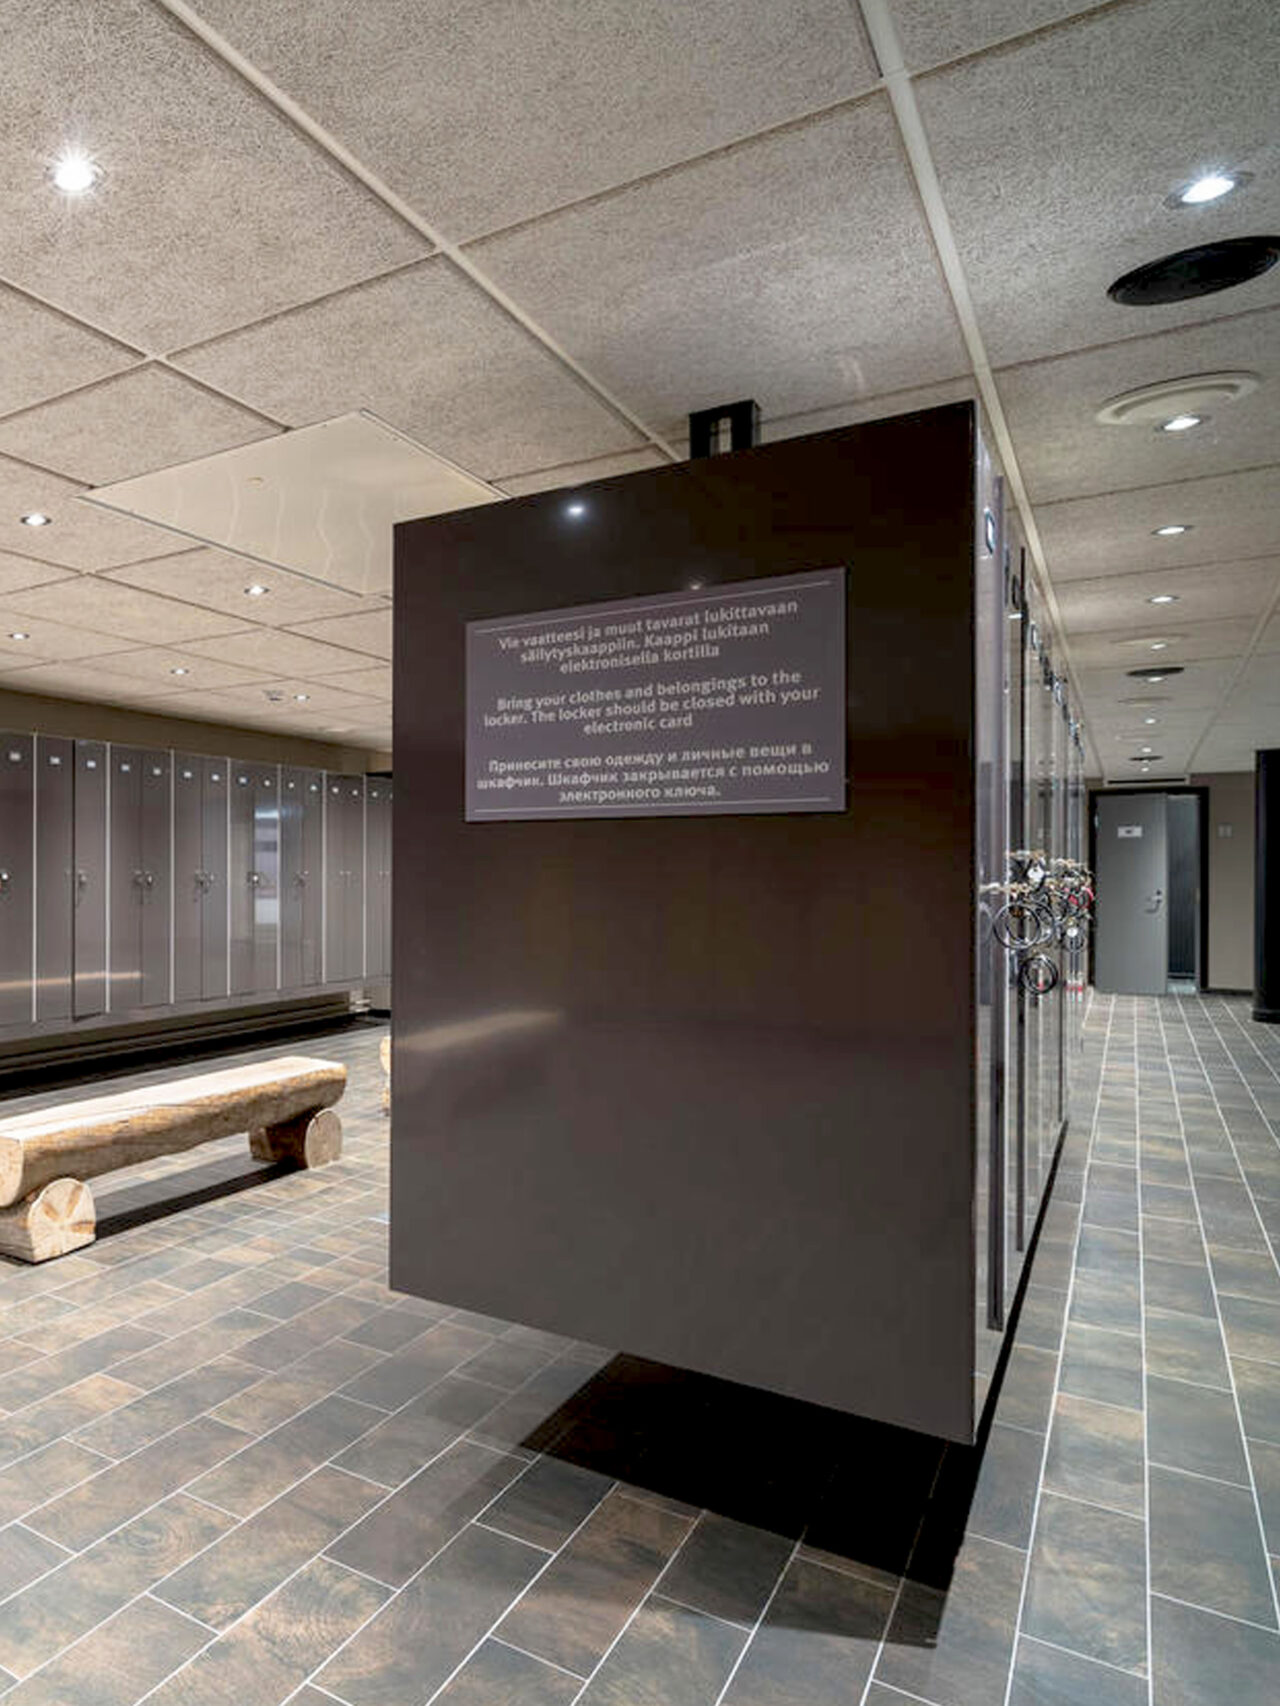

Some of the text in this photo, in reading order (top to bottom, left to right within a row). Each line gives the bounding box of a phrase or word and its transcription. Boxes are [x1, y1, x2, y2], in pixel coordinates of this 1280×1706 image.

[498, 601, 798, 650] Vie vaatteesi ja muut tavarat lukittavaan
[521, 622, 769, 663] säilytyskaappiin. Kaappi lukitaan
[560, 645, 720, 674] elektronisella kortilla
[497, 670, 801, 711] Bring your clothes and belongings to the
[484, 688, 821, 727] locker. The locker should be closed with your
[584, 714, 693, 735] electronic card
[488, 758, 561, 774] Принесите
[564, 756, 602, 768] свою
[605, 752, 663, 767] одежду
[682, 747, 745, 761] личные
[750, 744, 797, 758] вещи
[477, 775, 544, 790] шкафчик.
[548, 771, 618, 786] Шкафчик
[623, 766, 725, 784] закрывается
[742, 761, 830, 776] помощью
[560, 785, 721, 803] электронного ключа.
